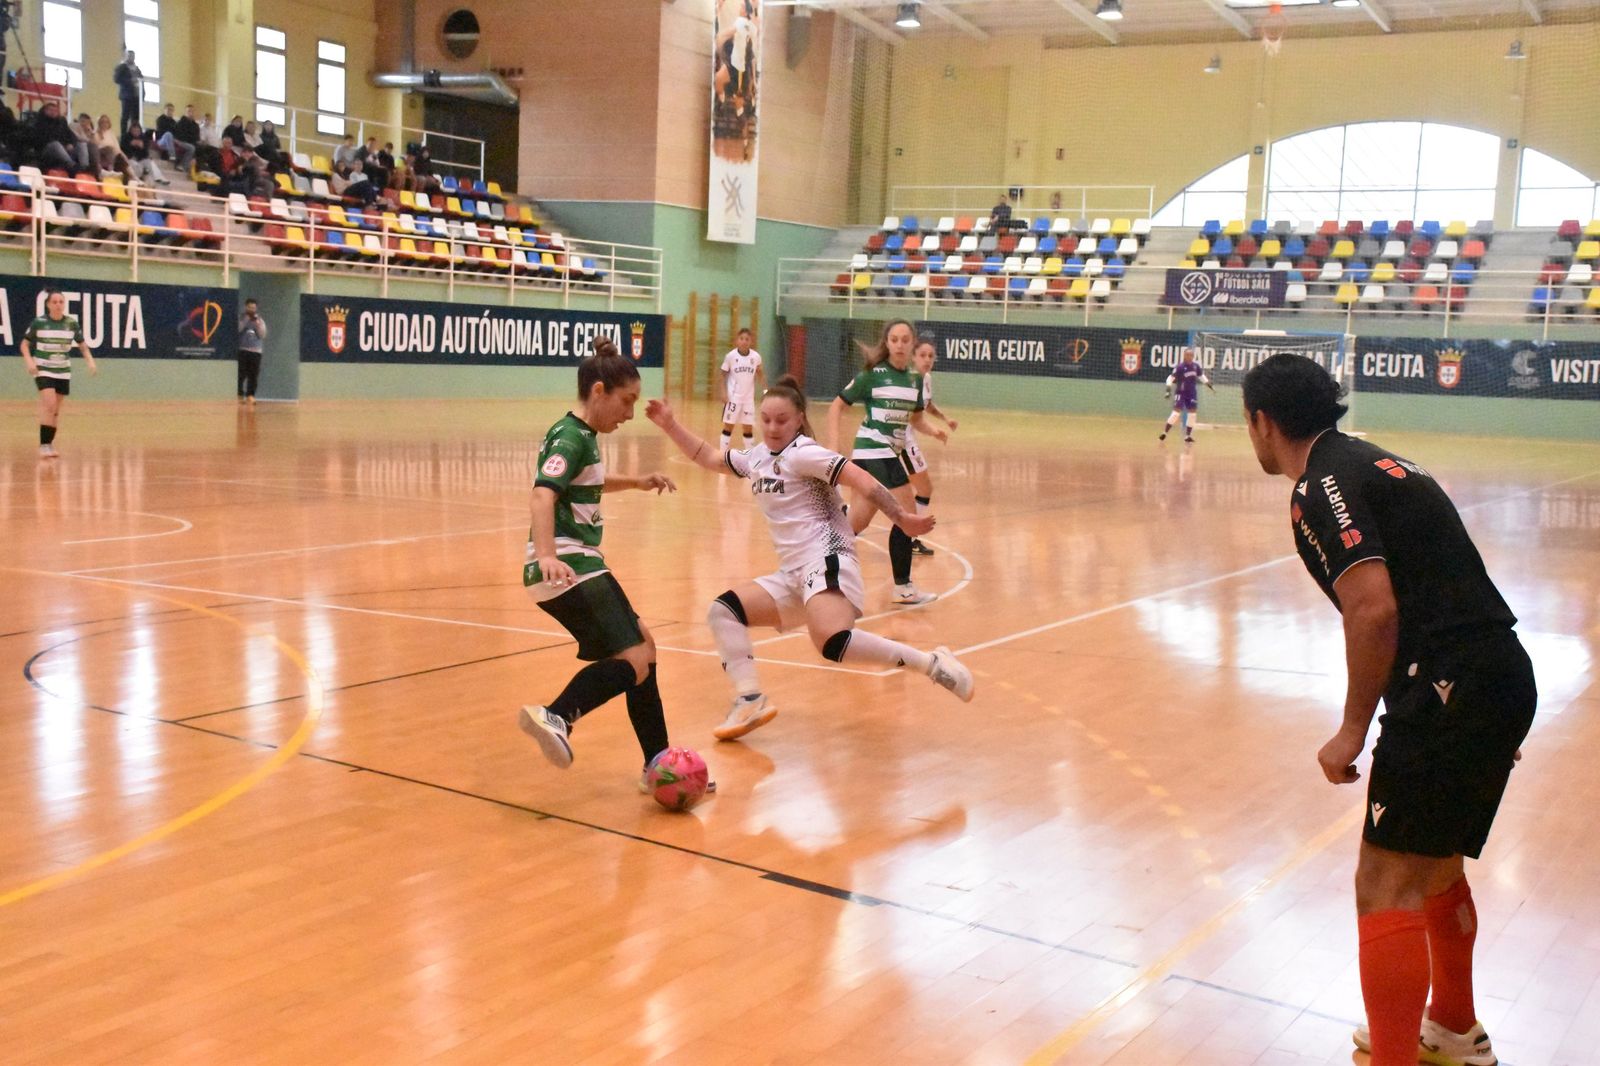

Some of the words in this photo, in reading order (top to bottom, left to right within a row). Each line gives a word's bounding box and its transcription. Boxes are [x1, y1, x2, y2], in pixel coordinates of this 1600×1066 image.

[359, 311, 436, 352] CIUDAD
[440, 309, 543, 356] AUTÓNOMA
[547, 320, 570, 356] DE
[945, 338, 991, 361] VISITA
[997, 339, 1046, 362] CEUTA
[1363, 353, 1425, 378] CEUTA
[727, 401, 737, 412] 13
[1320, 474, 1353, 529] WÜRTH
